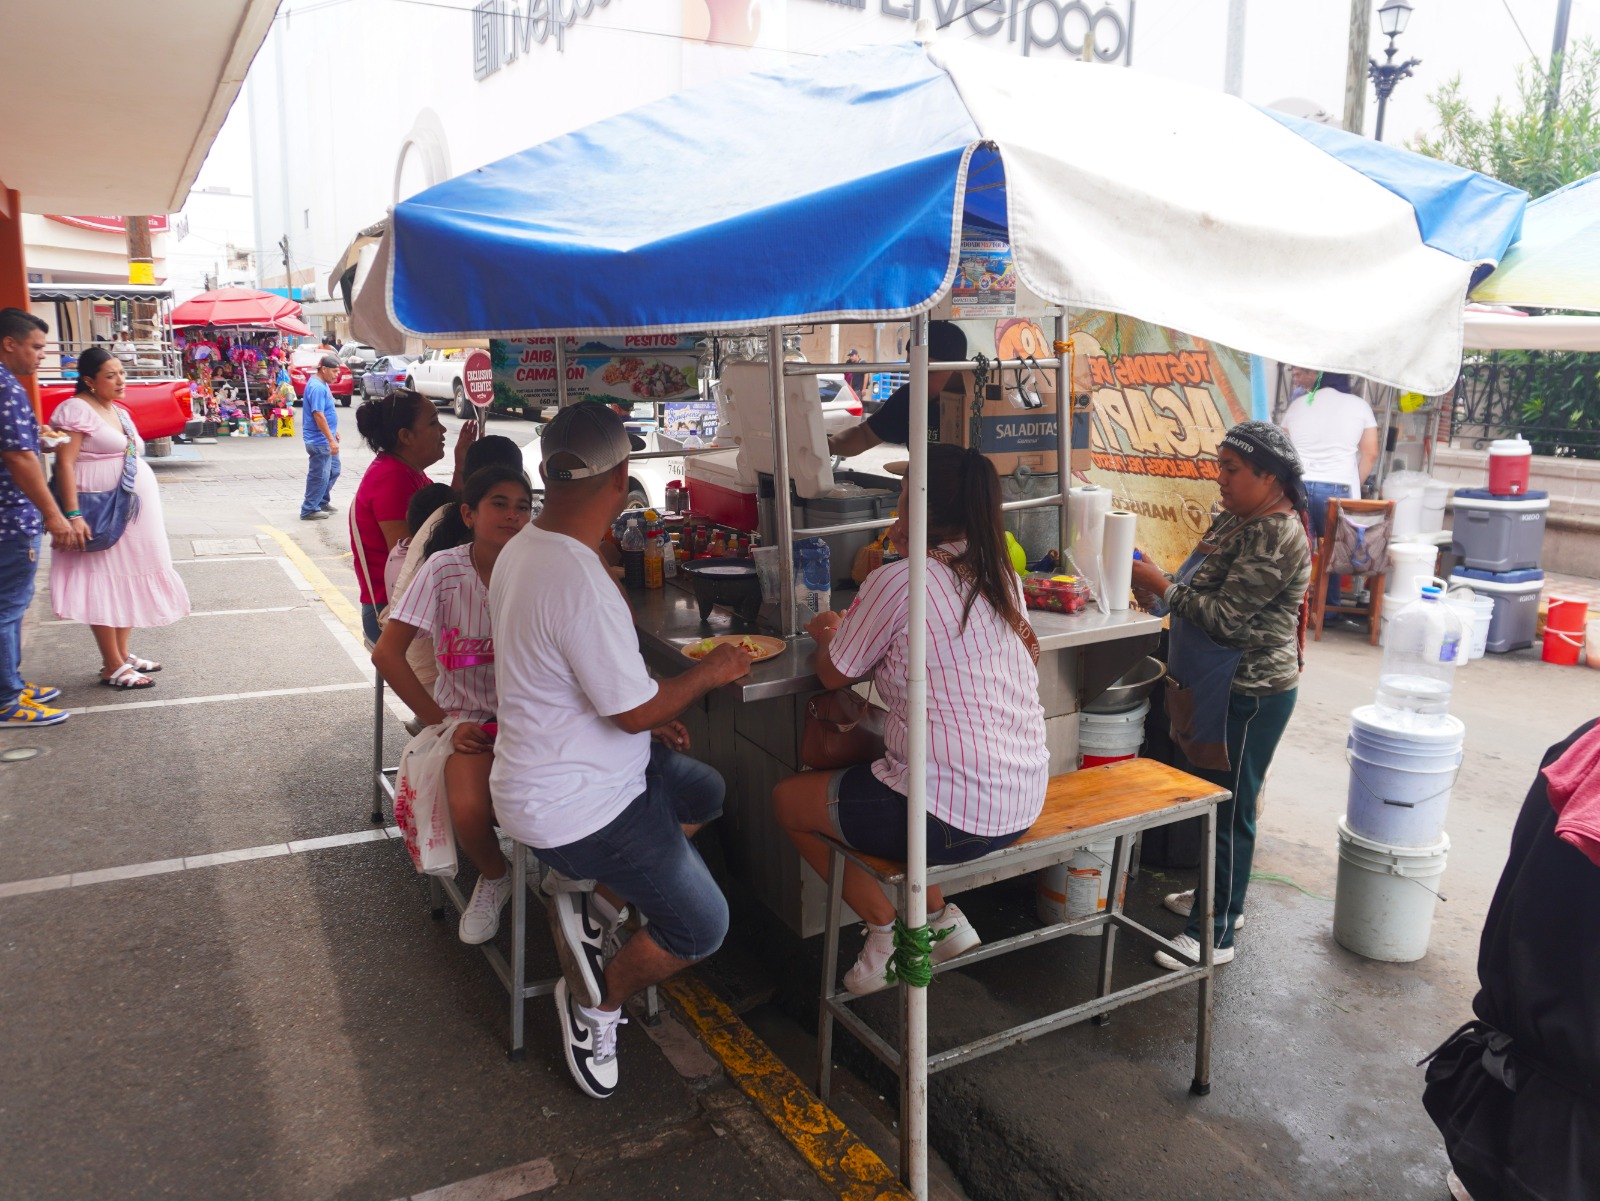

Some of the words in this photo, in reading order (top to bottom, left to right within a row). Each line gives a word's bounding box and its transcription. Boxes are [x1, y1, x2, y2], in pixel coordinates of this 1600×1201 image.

[625, 334, 677, 347] PESITOS
[467, 369, 493, 381] EXCLUSIVO
[516, 362, 585, 382] CAMAÓN
[470, 380, 493, 392] CLIENTES
